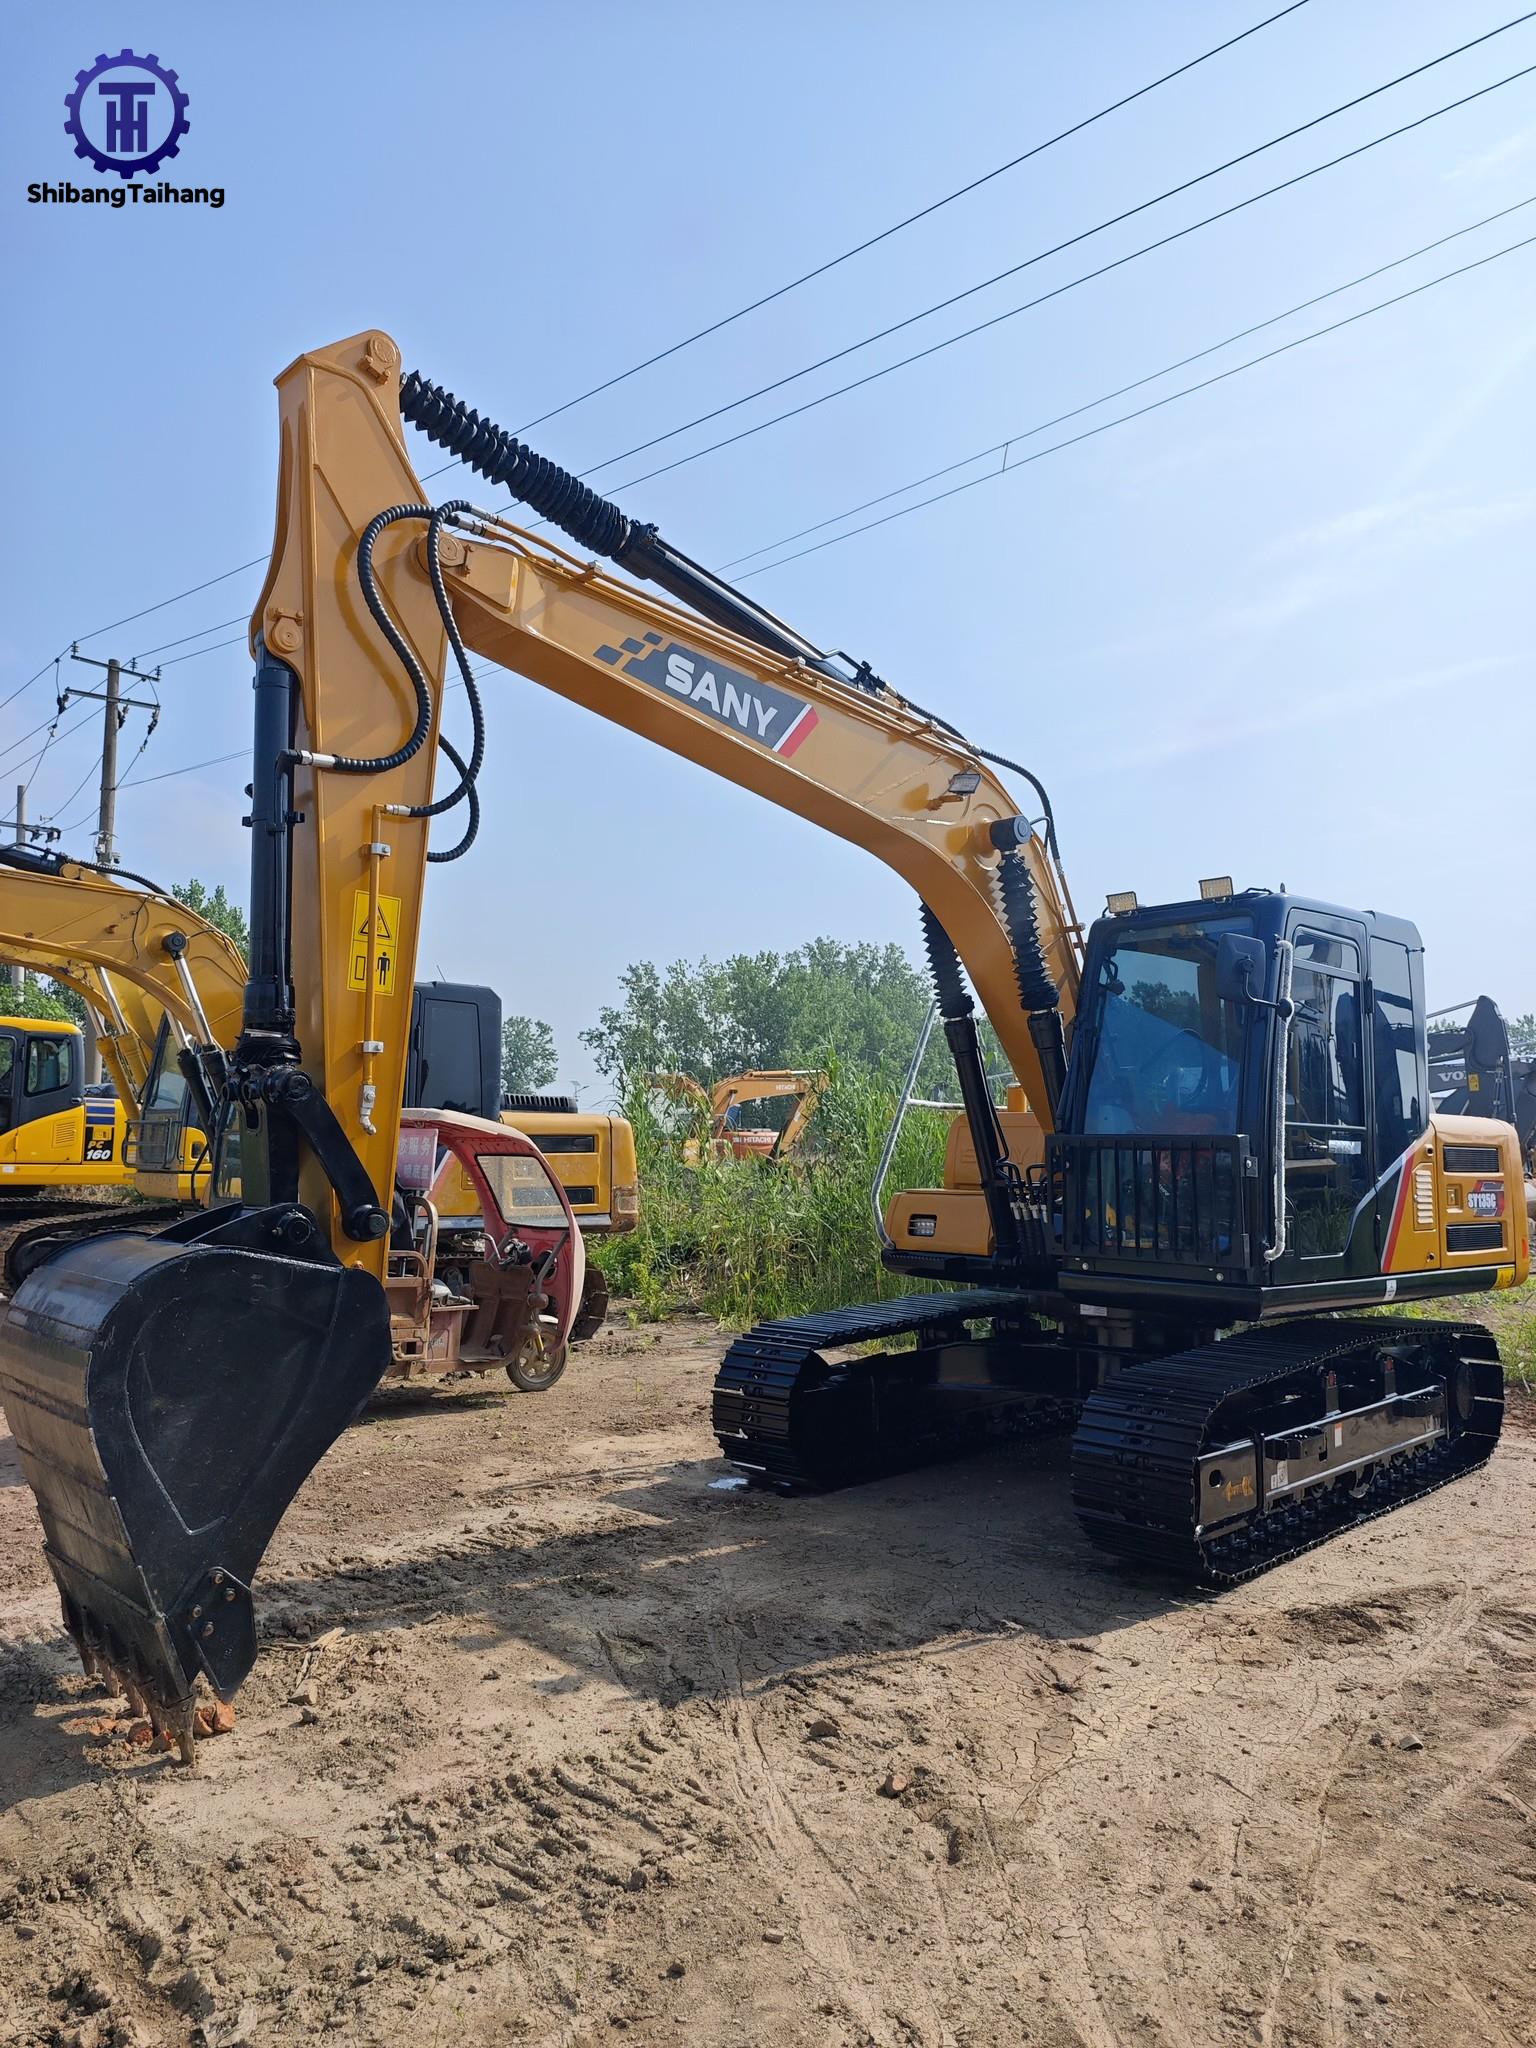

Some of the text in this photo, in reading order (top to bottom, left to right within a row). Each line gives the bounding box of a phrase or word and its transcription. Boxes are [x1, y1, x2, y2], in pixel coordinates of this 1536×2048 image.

[665, 653, 778, 737] SANY
[1437, 1071, 1467, 1082] VO
[87, 1140, 105, 1149] PC
[86, 1149, 111, 1160] 160
